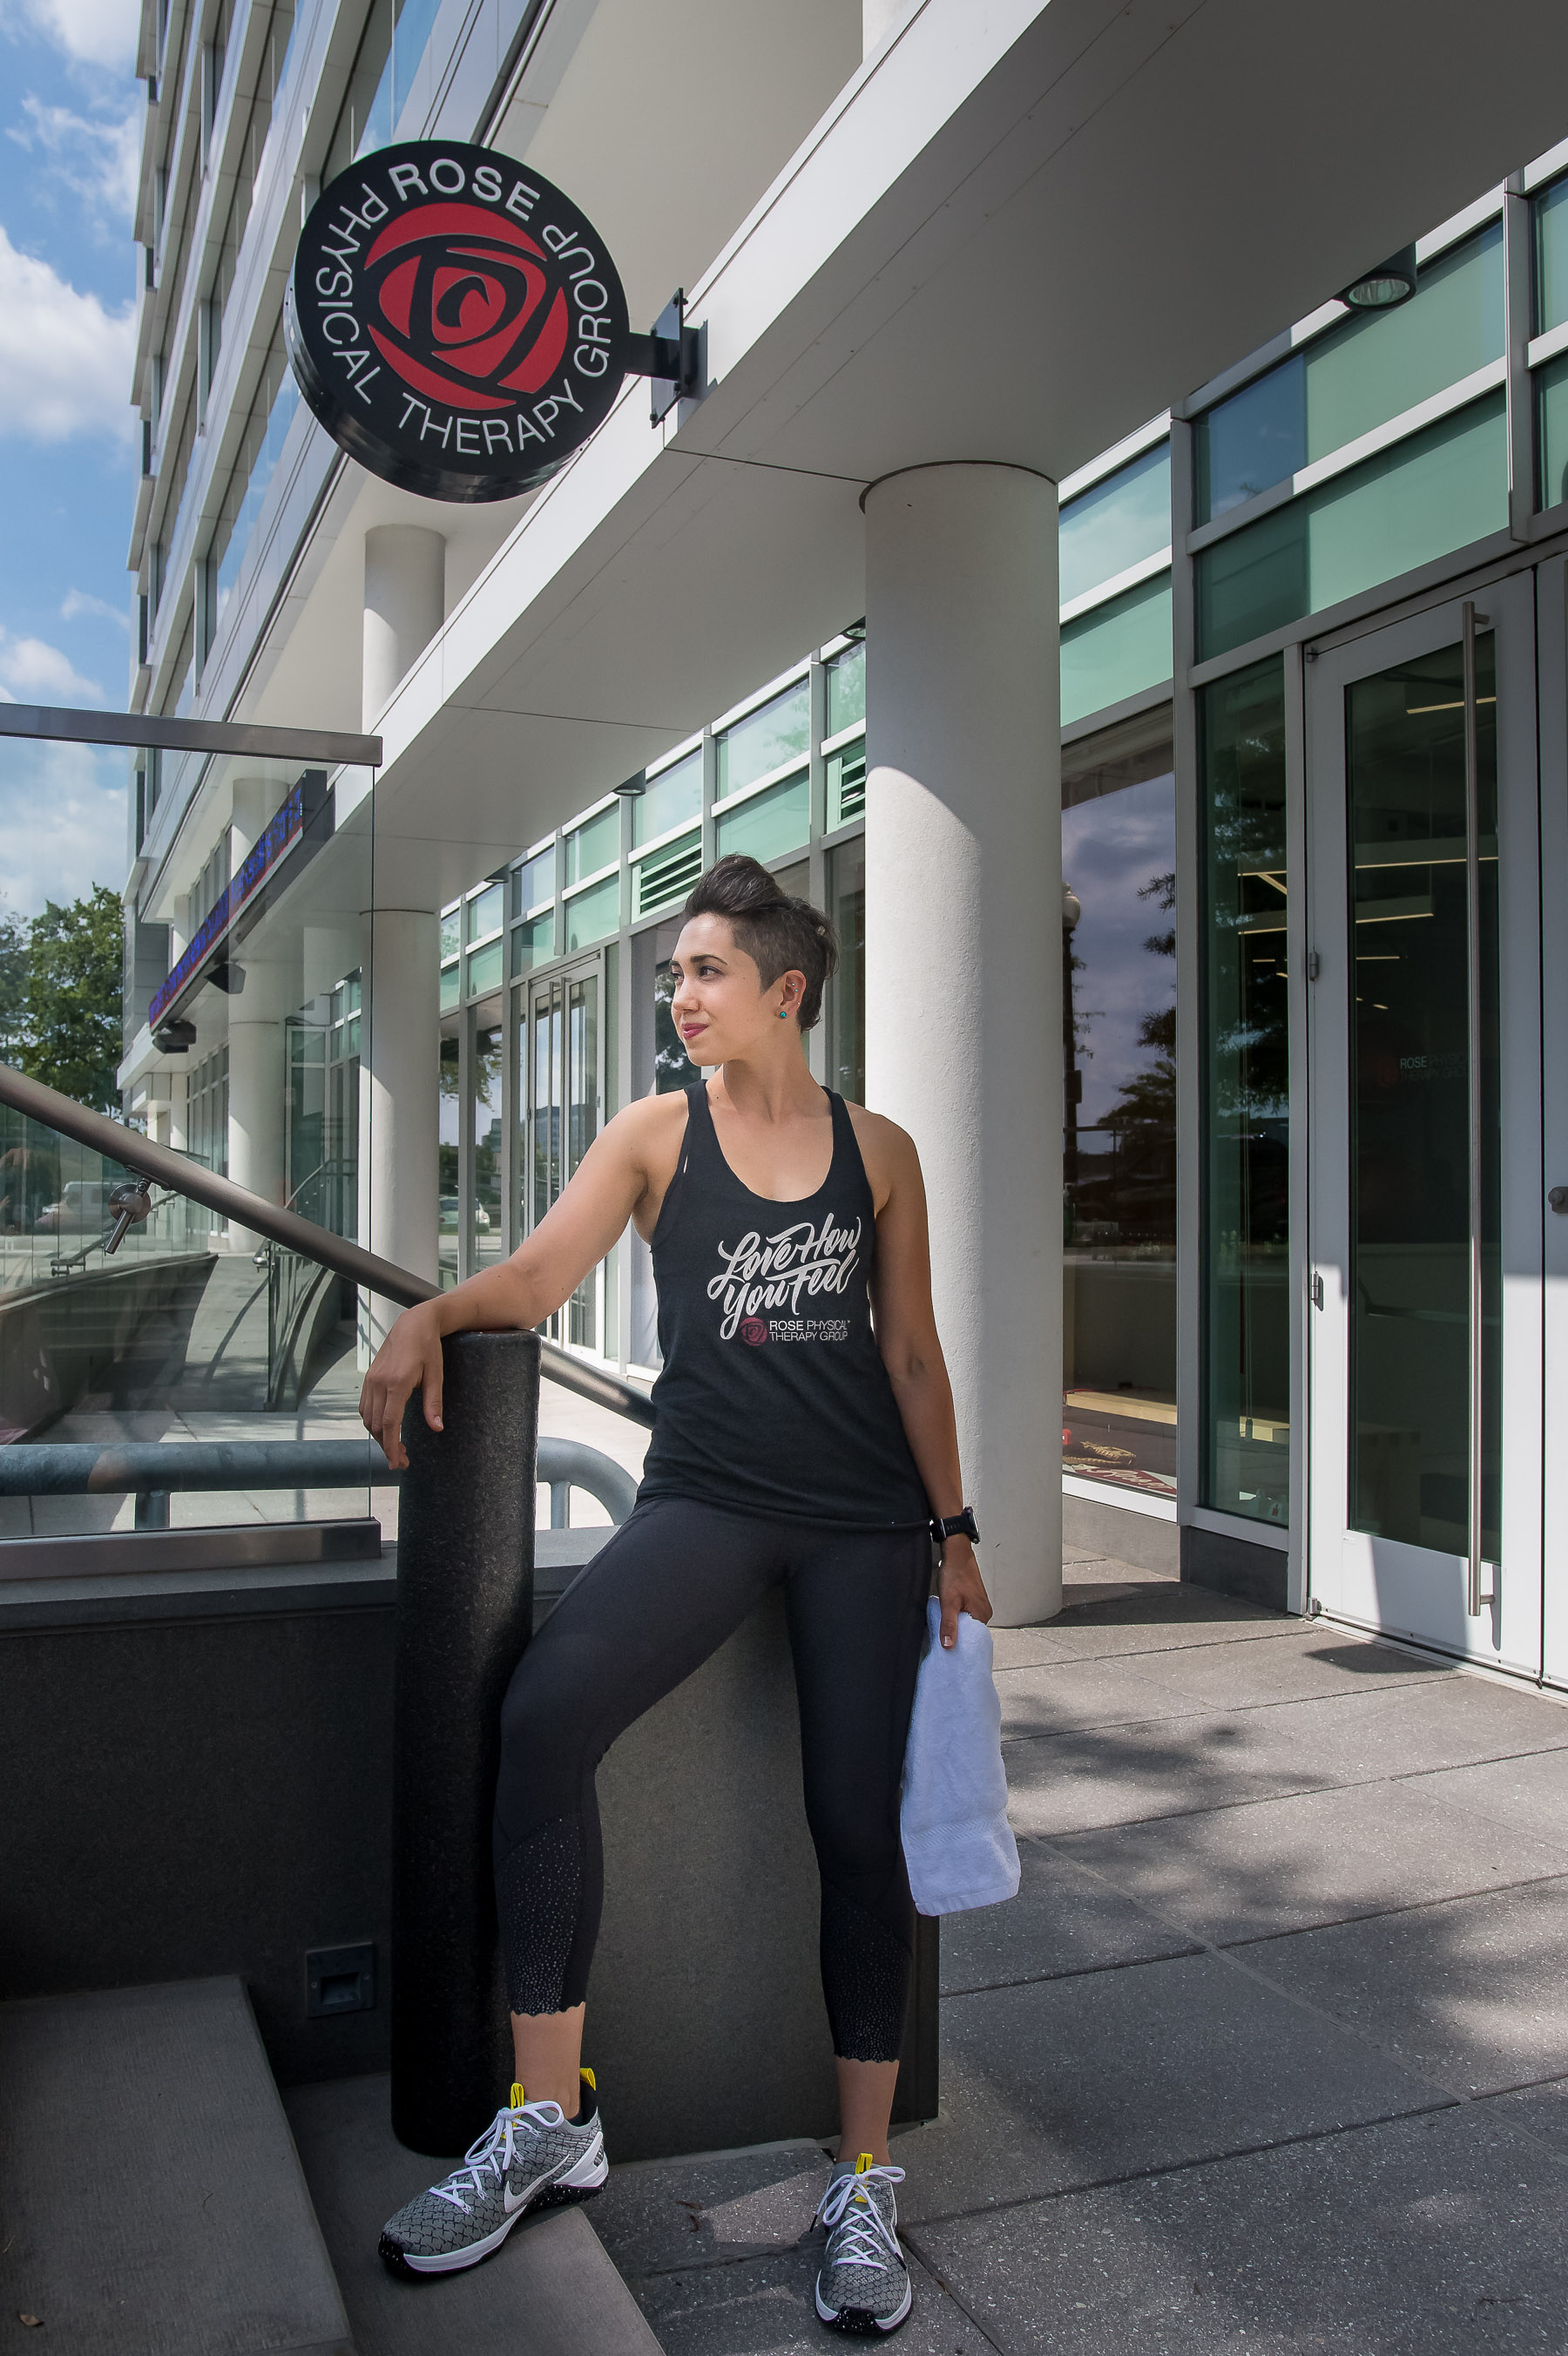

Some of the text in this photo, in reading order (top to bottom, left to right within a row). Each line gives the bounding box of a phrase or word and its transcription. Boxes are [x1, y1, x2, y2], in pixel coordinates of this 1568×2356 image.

[389, 158, 540, 220] ROSE
[315, 183, 612, 454] PHYSICAL THERAPY GROUP
[1400, 1055, 1428, 1069] ROSE
[707, 1212, 862, 1299] Love How
[765, 1249, 860, 1316] Feel
[769, 1319, 848, 1331] ROSE PHYSICAL
[769, 1330, 848, 1342] THERAPY GROUP
